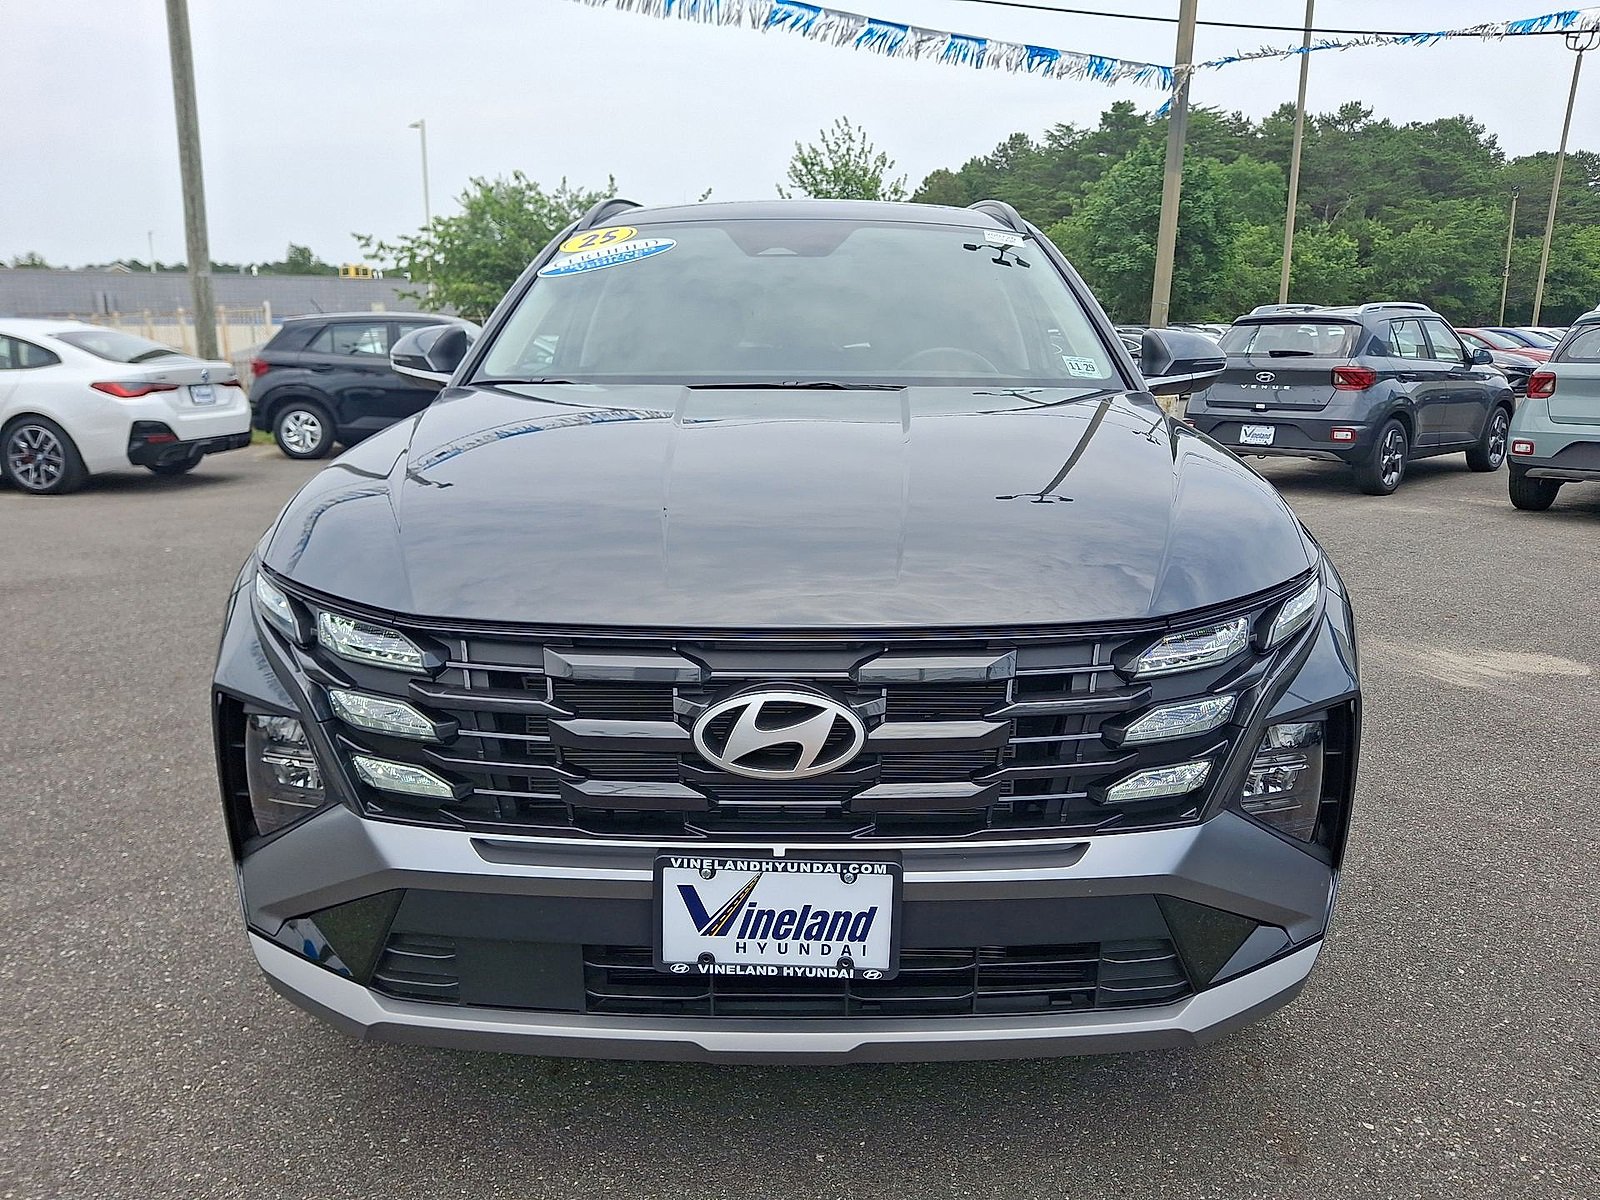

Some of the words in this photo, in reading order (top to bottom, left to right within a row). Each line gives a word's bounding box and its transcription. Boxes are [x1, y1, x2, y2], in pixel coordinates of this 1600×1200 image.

[578, 229, 620, 249] 25
[1068, 361, 1082, 371] 11
[1083, 363, 1096, 372] 29
[670, 857, 888, 875] VINELANDHYUNDAI.COM
[676, 872, 878, 943] Vineland
[735, 942, 867, 957] HYUNDAI
[698, 964, 779, 977] VINELAND
[783, 966, 855, 979] HYUNDAI
